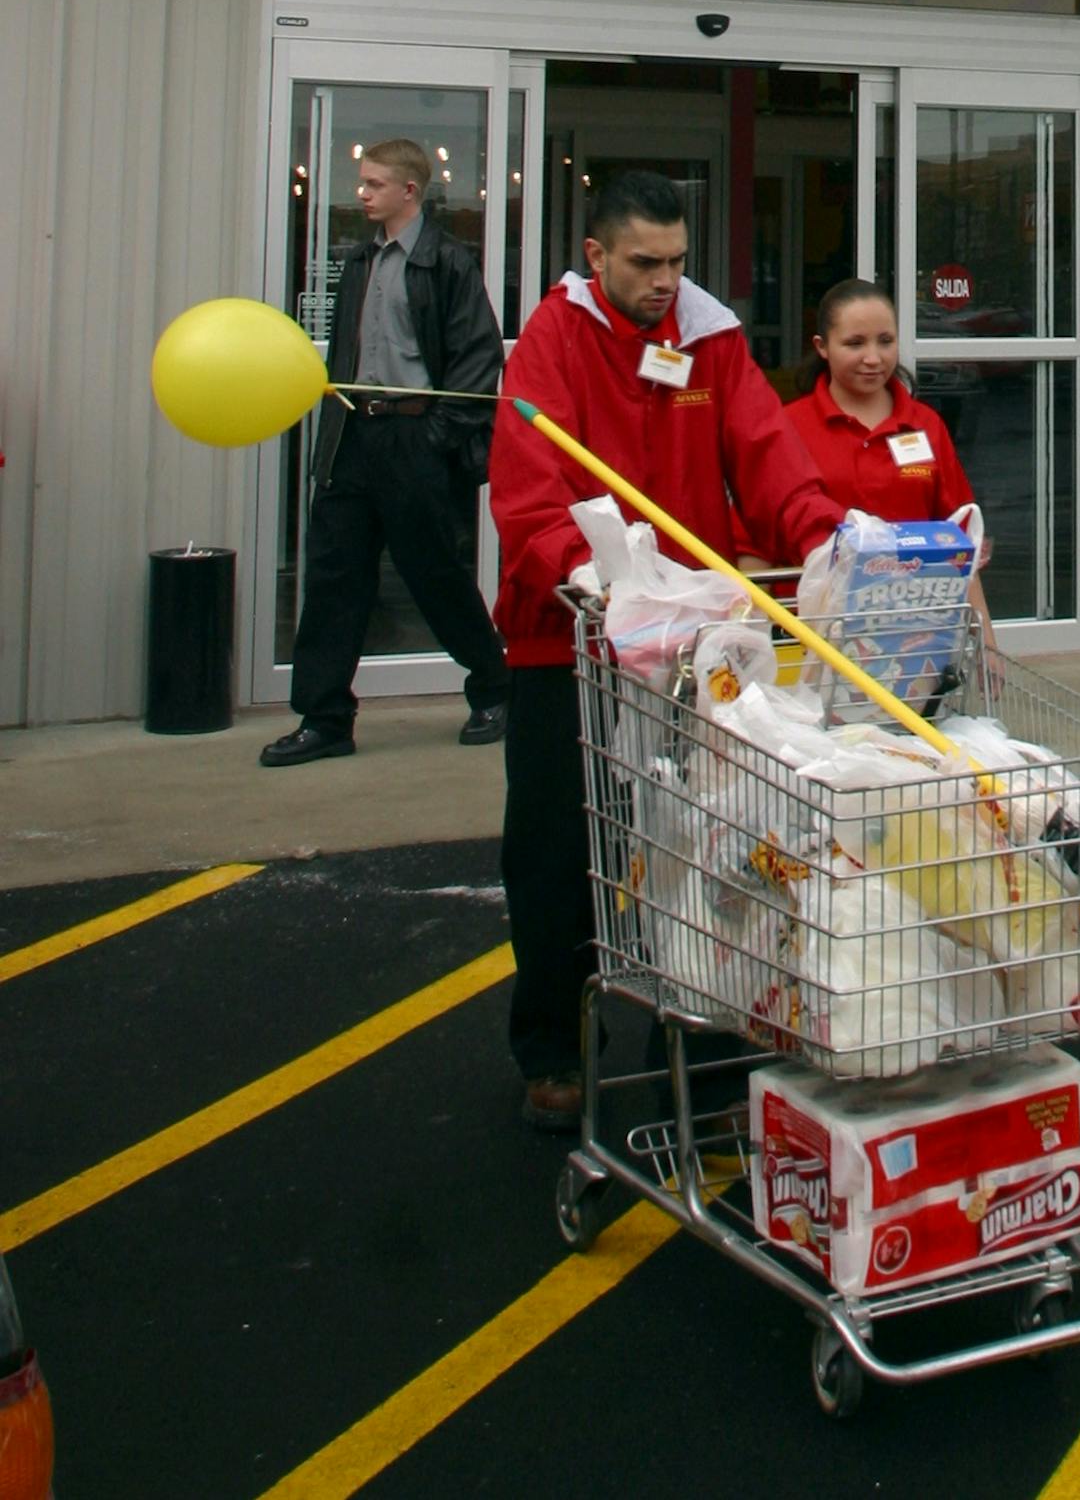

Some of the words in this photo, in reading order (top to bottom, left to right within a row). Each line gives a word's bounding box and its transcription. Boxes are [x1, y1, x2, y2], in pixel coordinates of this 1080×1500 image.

[935, 278, 970, 299] SALIDA
[857, 577, 966, 607] FROSTED
[981, 1170, 1080, 1243] Charmin
